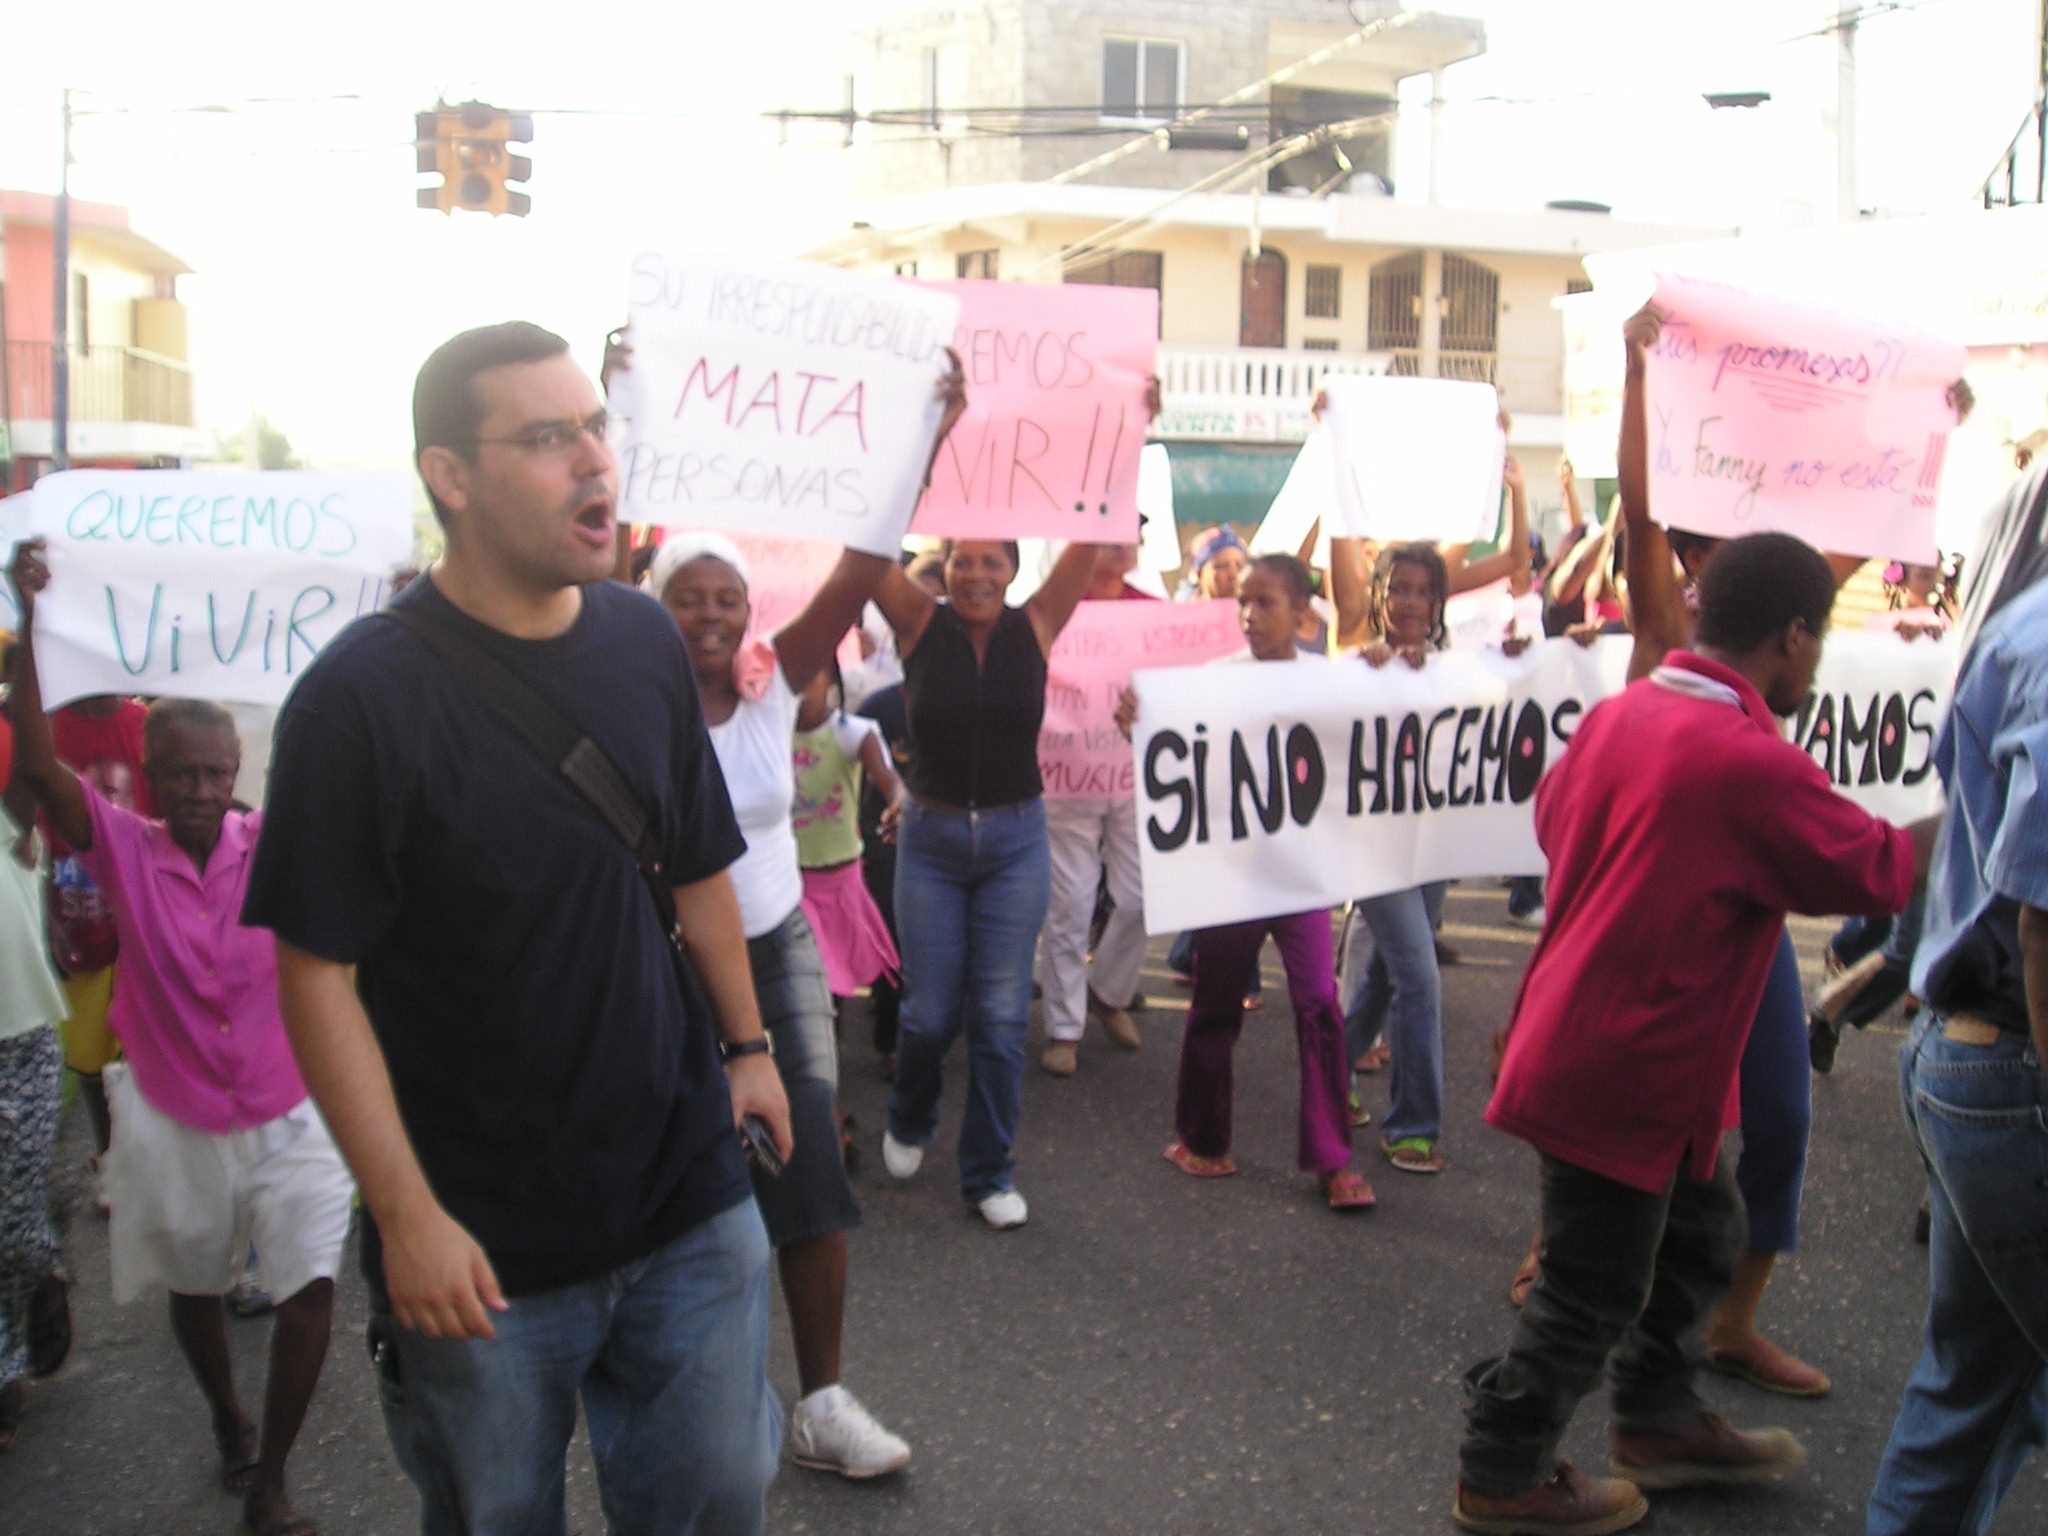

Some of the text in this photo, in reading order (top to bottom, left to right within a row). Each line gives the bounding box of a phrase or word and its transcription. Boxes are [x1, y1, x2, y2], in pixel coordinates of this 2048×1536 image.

[631, 252, 685, 310] SU
[674, 356, 868, 452] MATA
[1160, 421, 1234, 434] VENTA
[624, 442, 870, 519] PERSONAS
[1694, 414, 1767, 521] Fanny
[1782, 459, 1834, 488] no
[66, 489, 357, 558] QUEREMOS
[1230, 721, 1327, 842] NO
